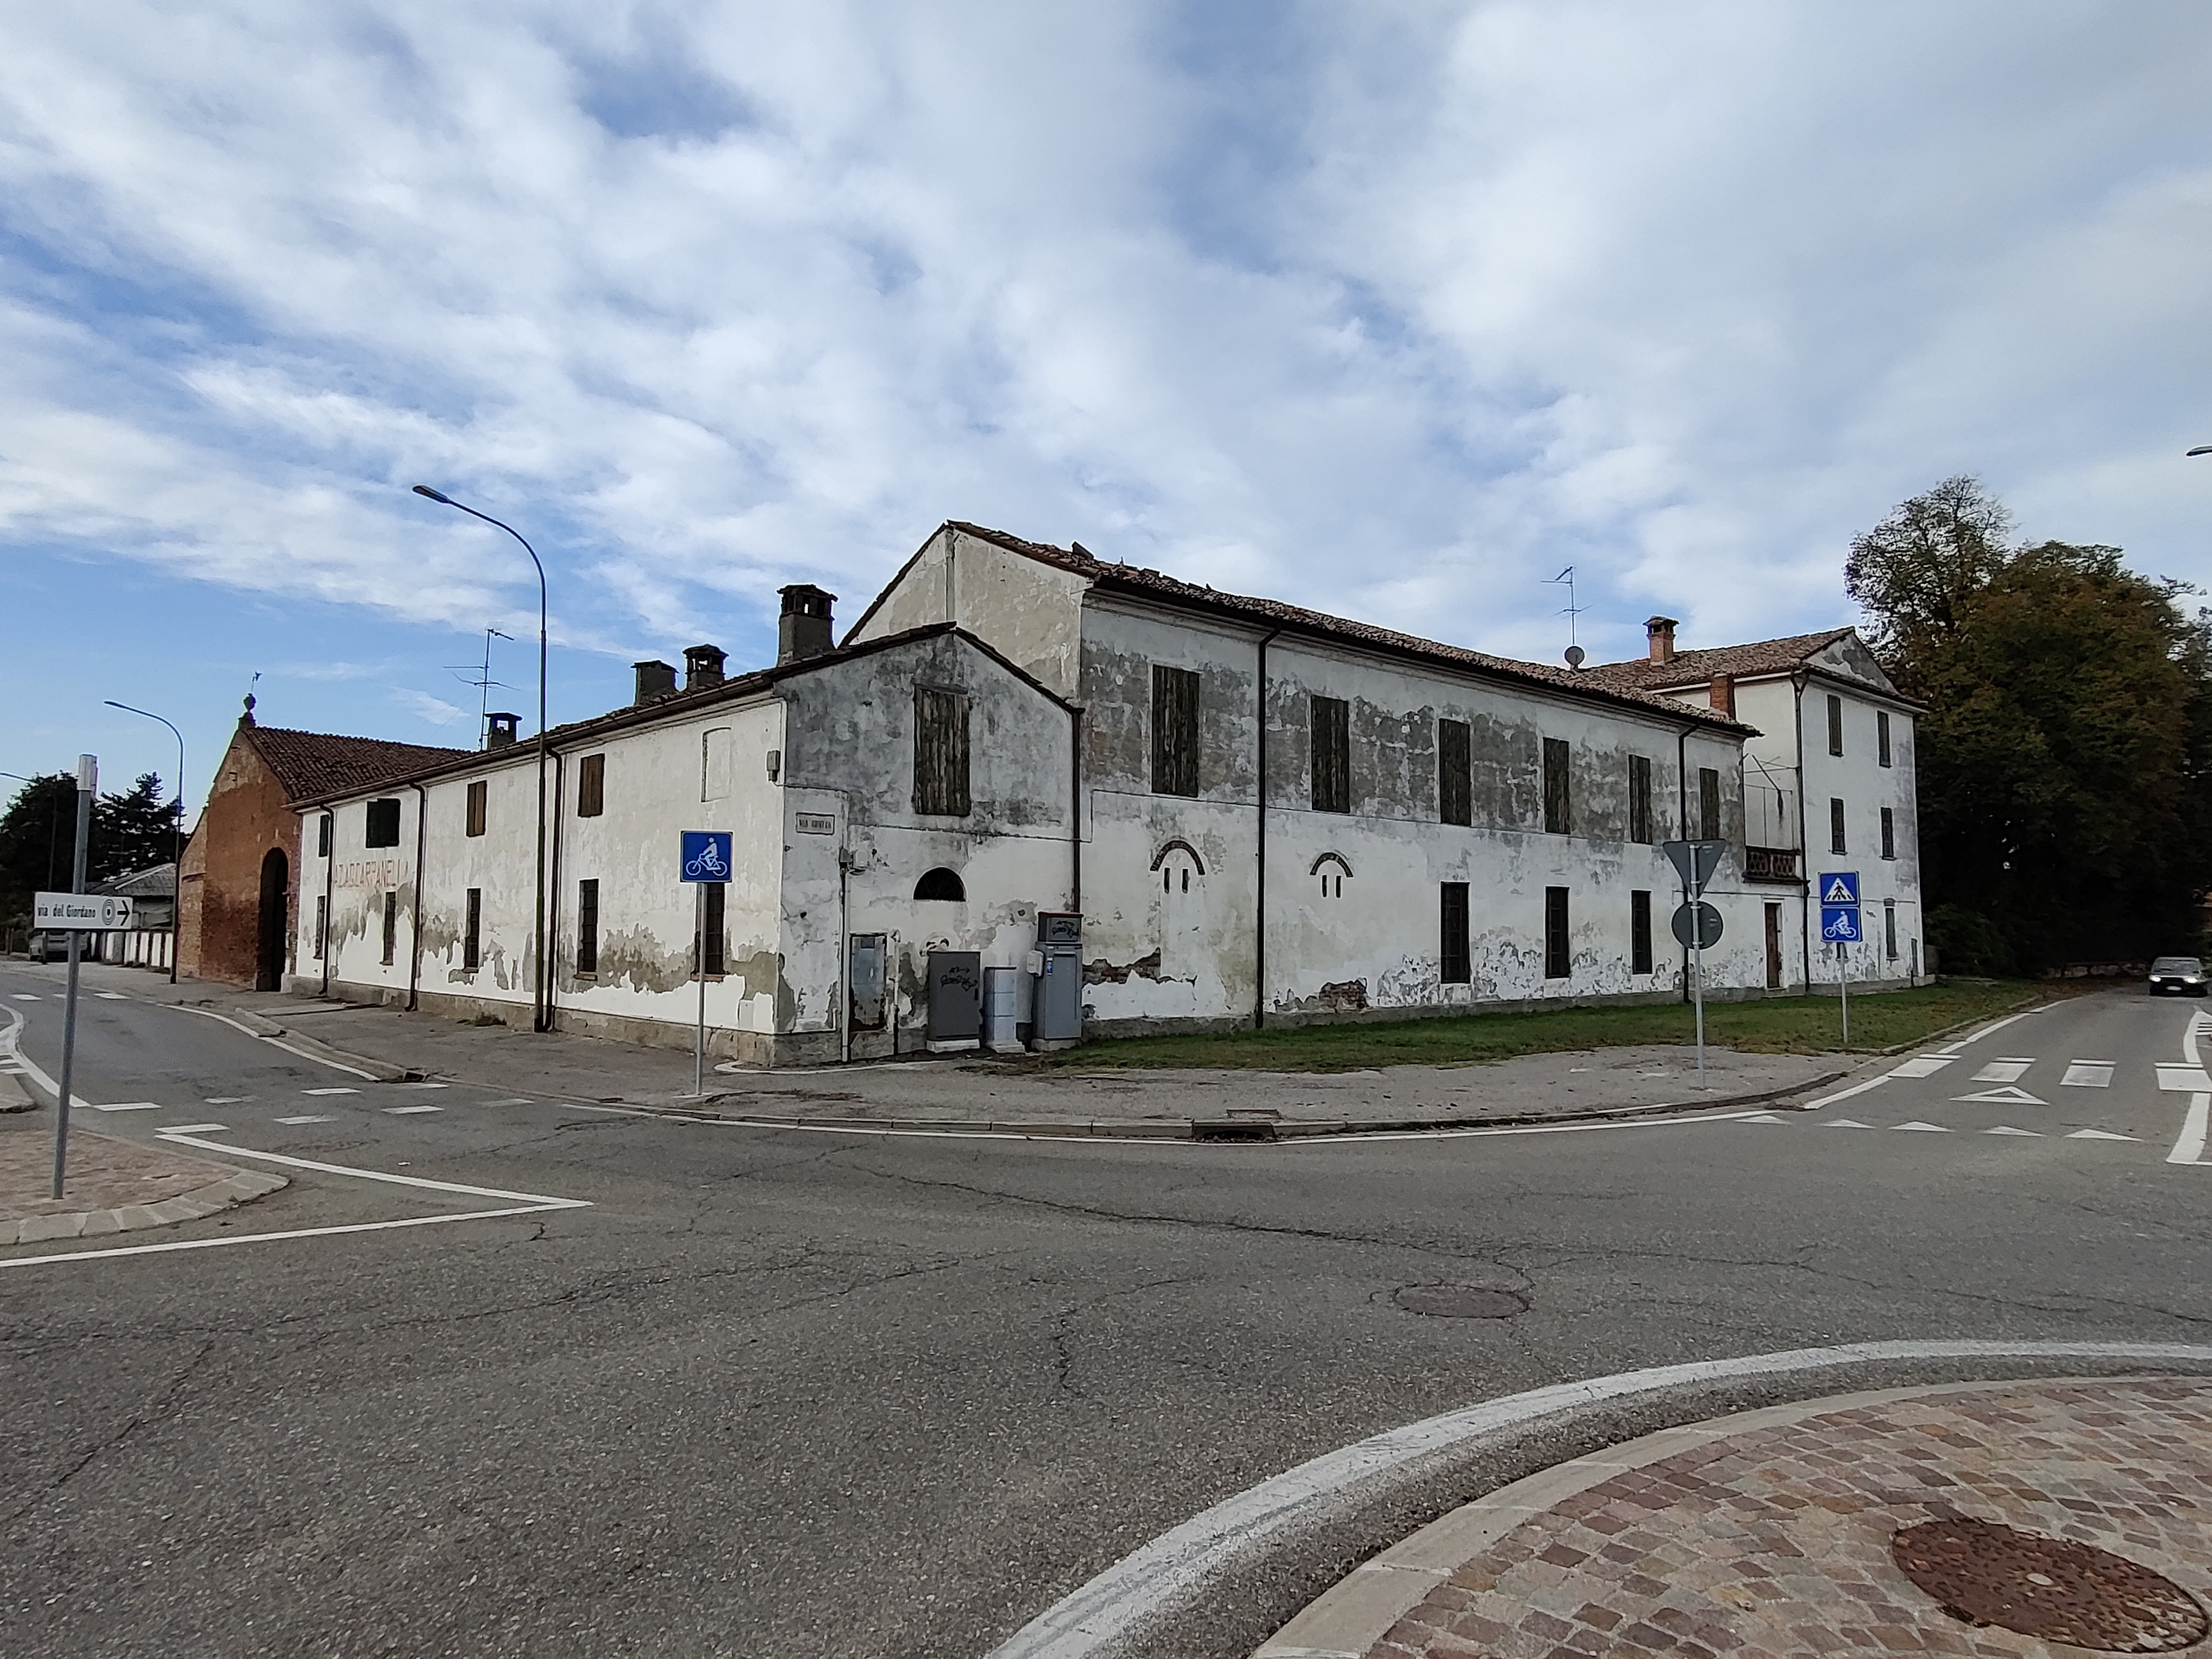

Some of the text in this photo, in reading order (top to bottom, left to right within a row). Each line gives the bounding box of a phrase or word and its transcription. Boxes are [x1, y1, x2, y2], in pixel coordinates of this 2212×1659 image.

[38, 903, 96, 918] via del Giordano
